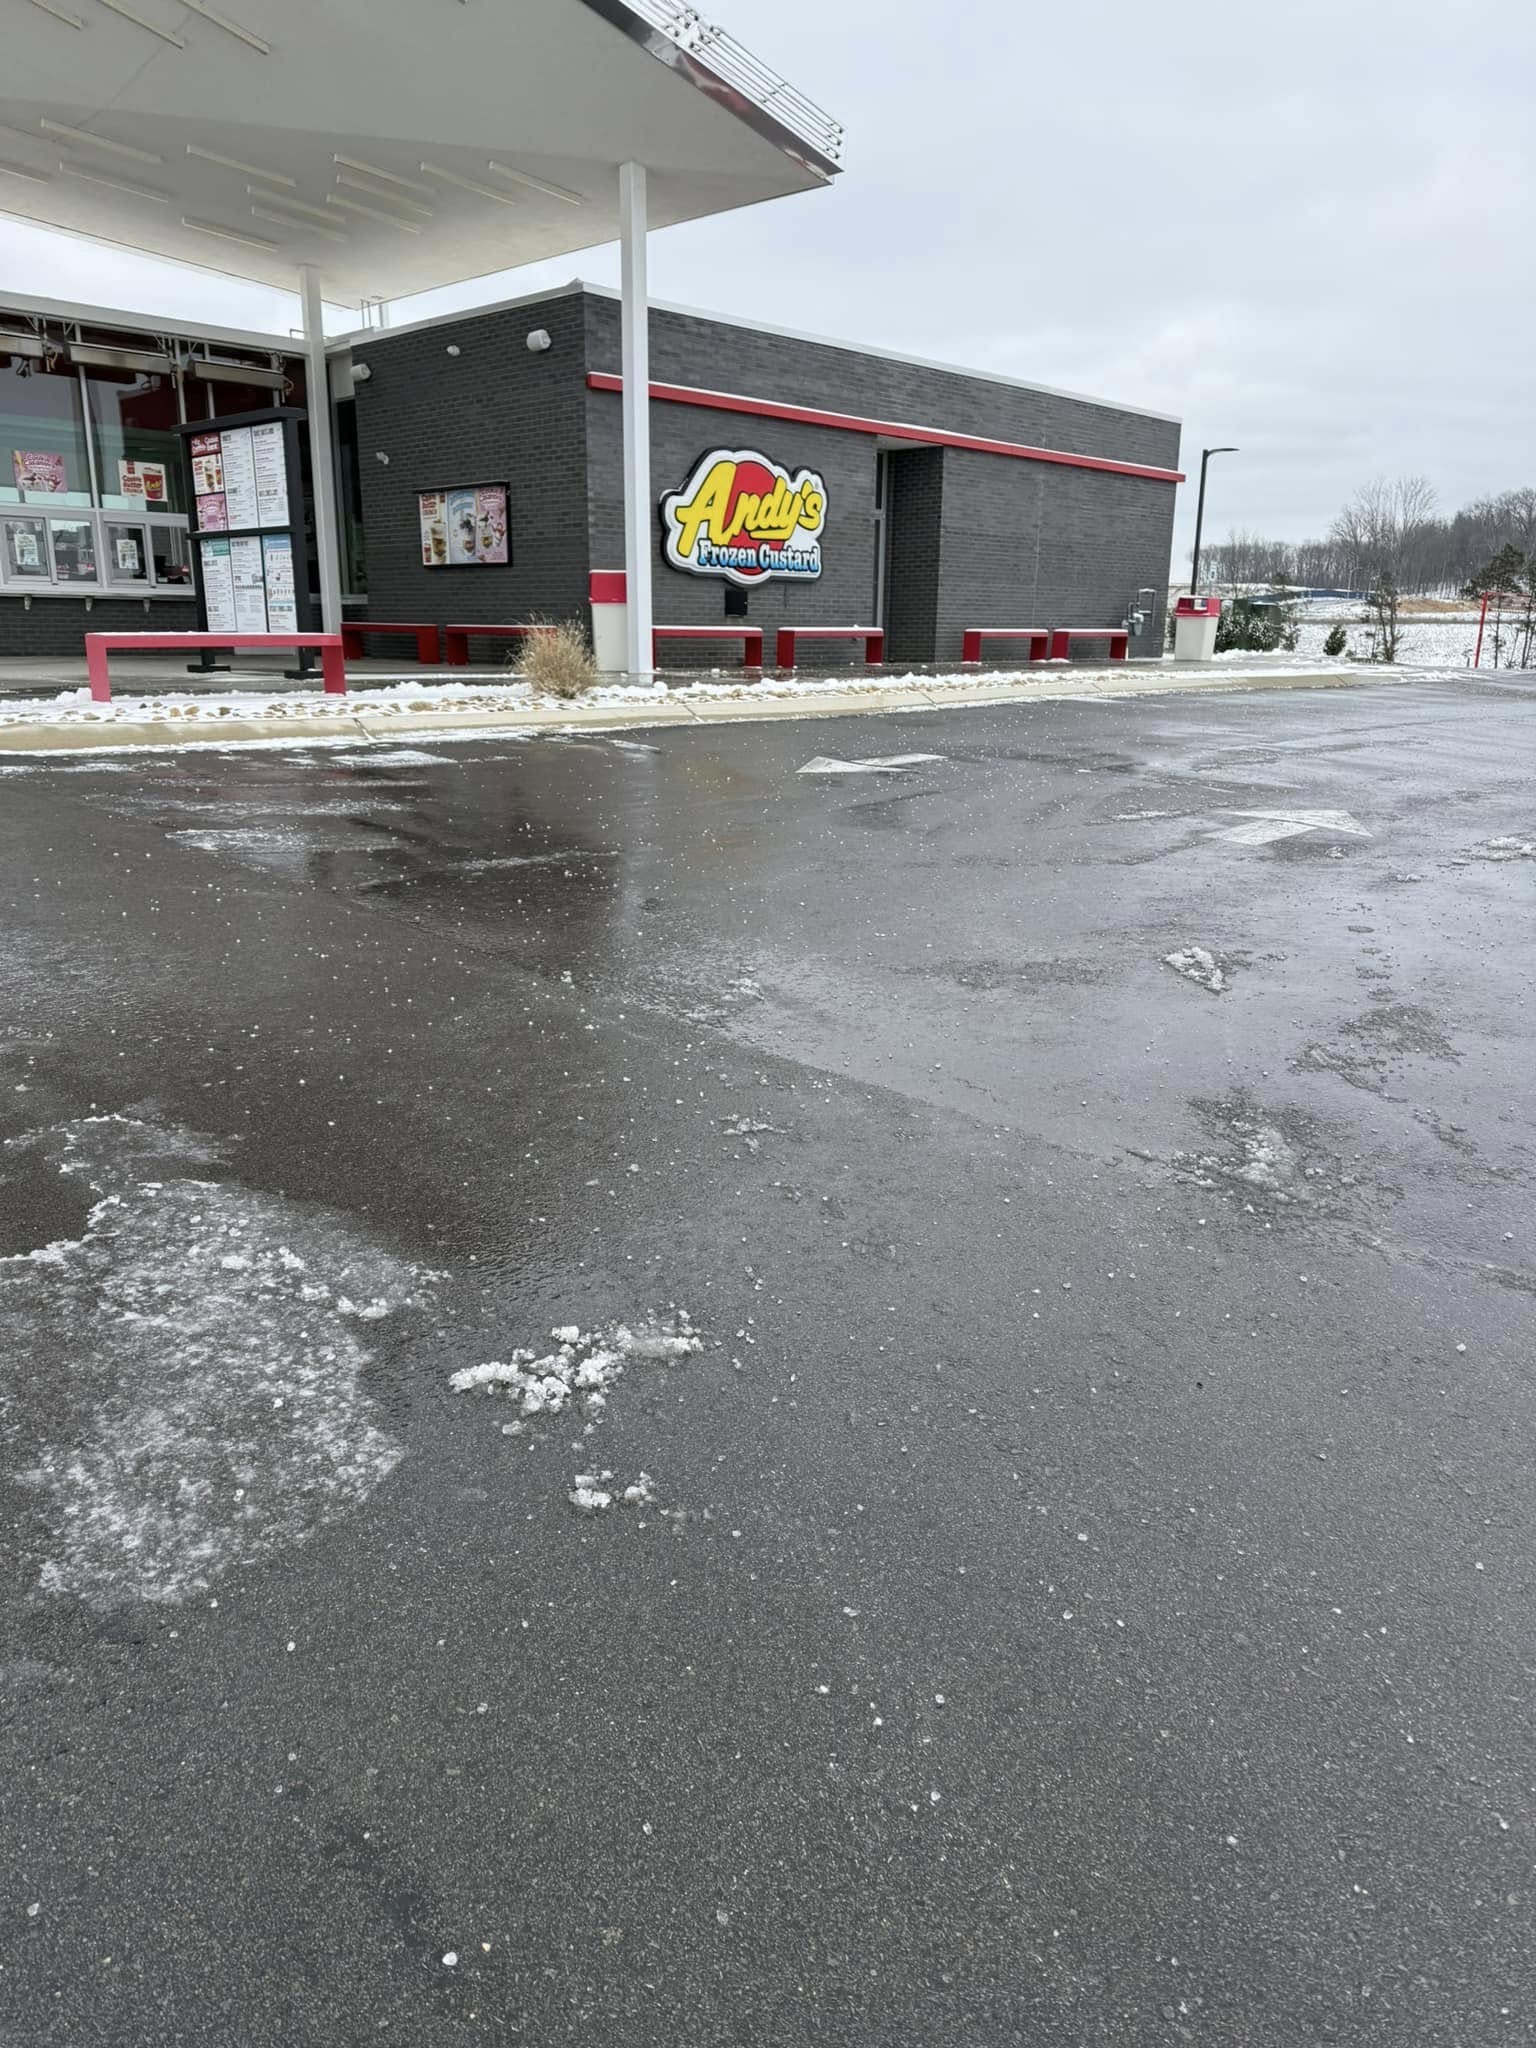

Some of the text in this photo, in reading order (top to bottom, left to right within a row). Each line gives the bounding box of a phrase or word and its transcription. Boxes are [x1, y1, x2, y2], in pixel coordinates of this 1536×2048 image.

[674, 460, 823, 557] Andy's
[698, 539, 819, 572] Frozen Custard
